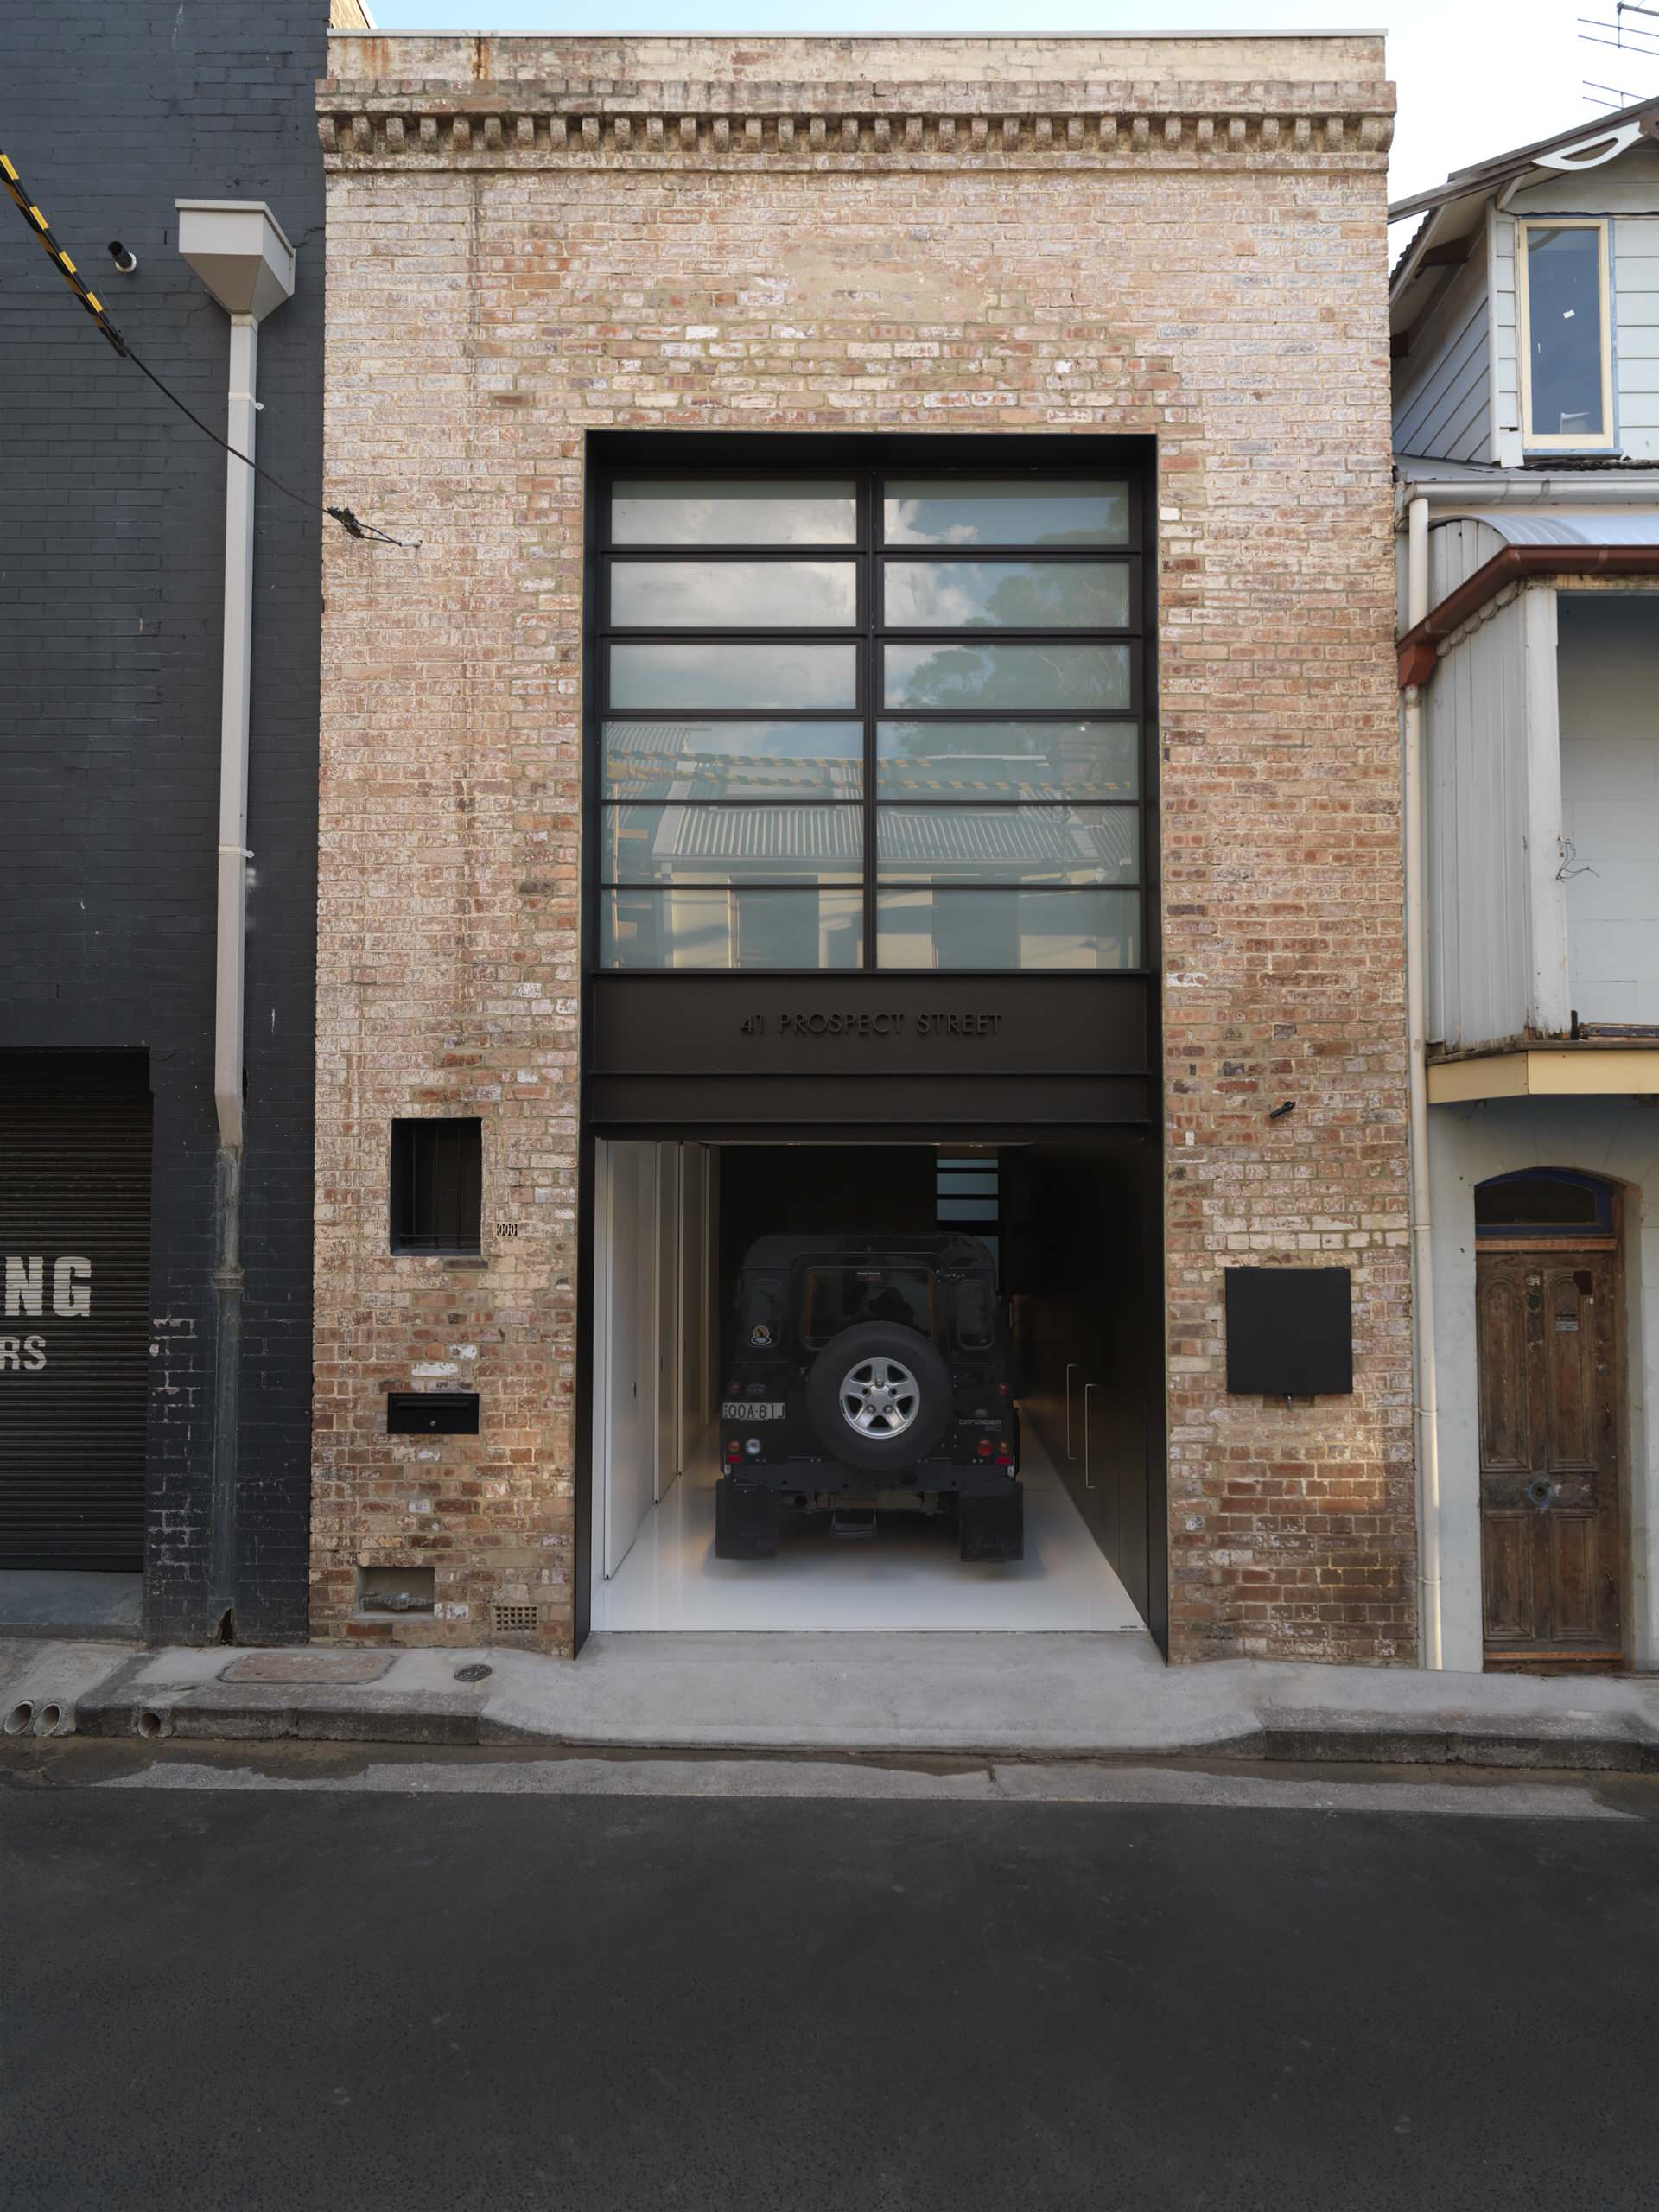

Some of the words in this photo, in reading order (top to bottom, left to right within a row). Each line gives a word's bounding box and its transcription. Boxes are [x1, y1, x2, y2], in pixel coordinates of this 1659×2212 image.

[741, 1013, 764, 1034] 41
[779, 1013, 905, 1035] PROSPECT
[917, 1013, 1002, 1035] STREET
[5, 1256, 92, 1317] NG
[0, 1335, 47, 1370] RS
